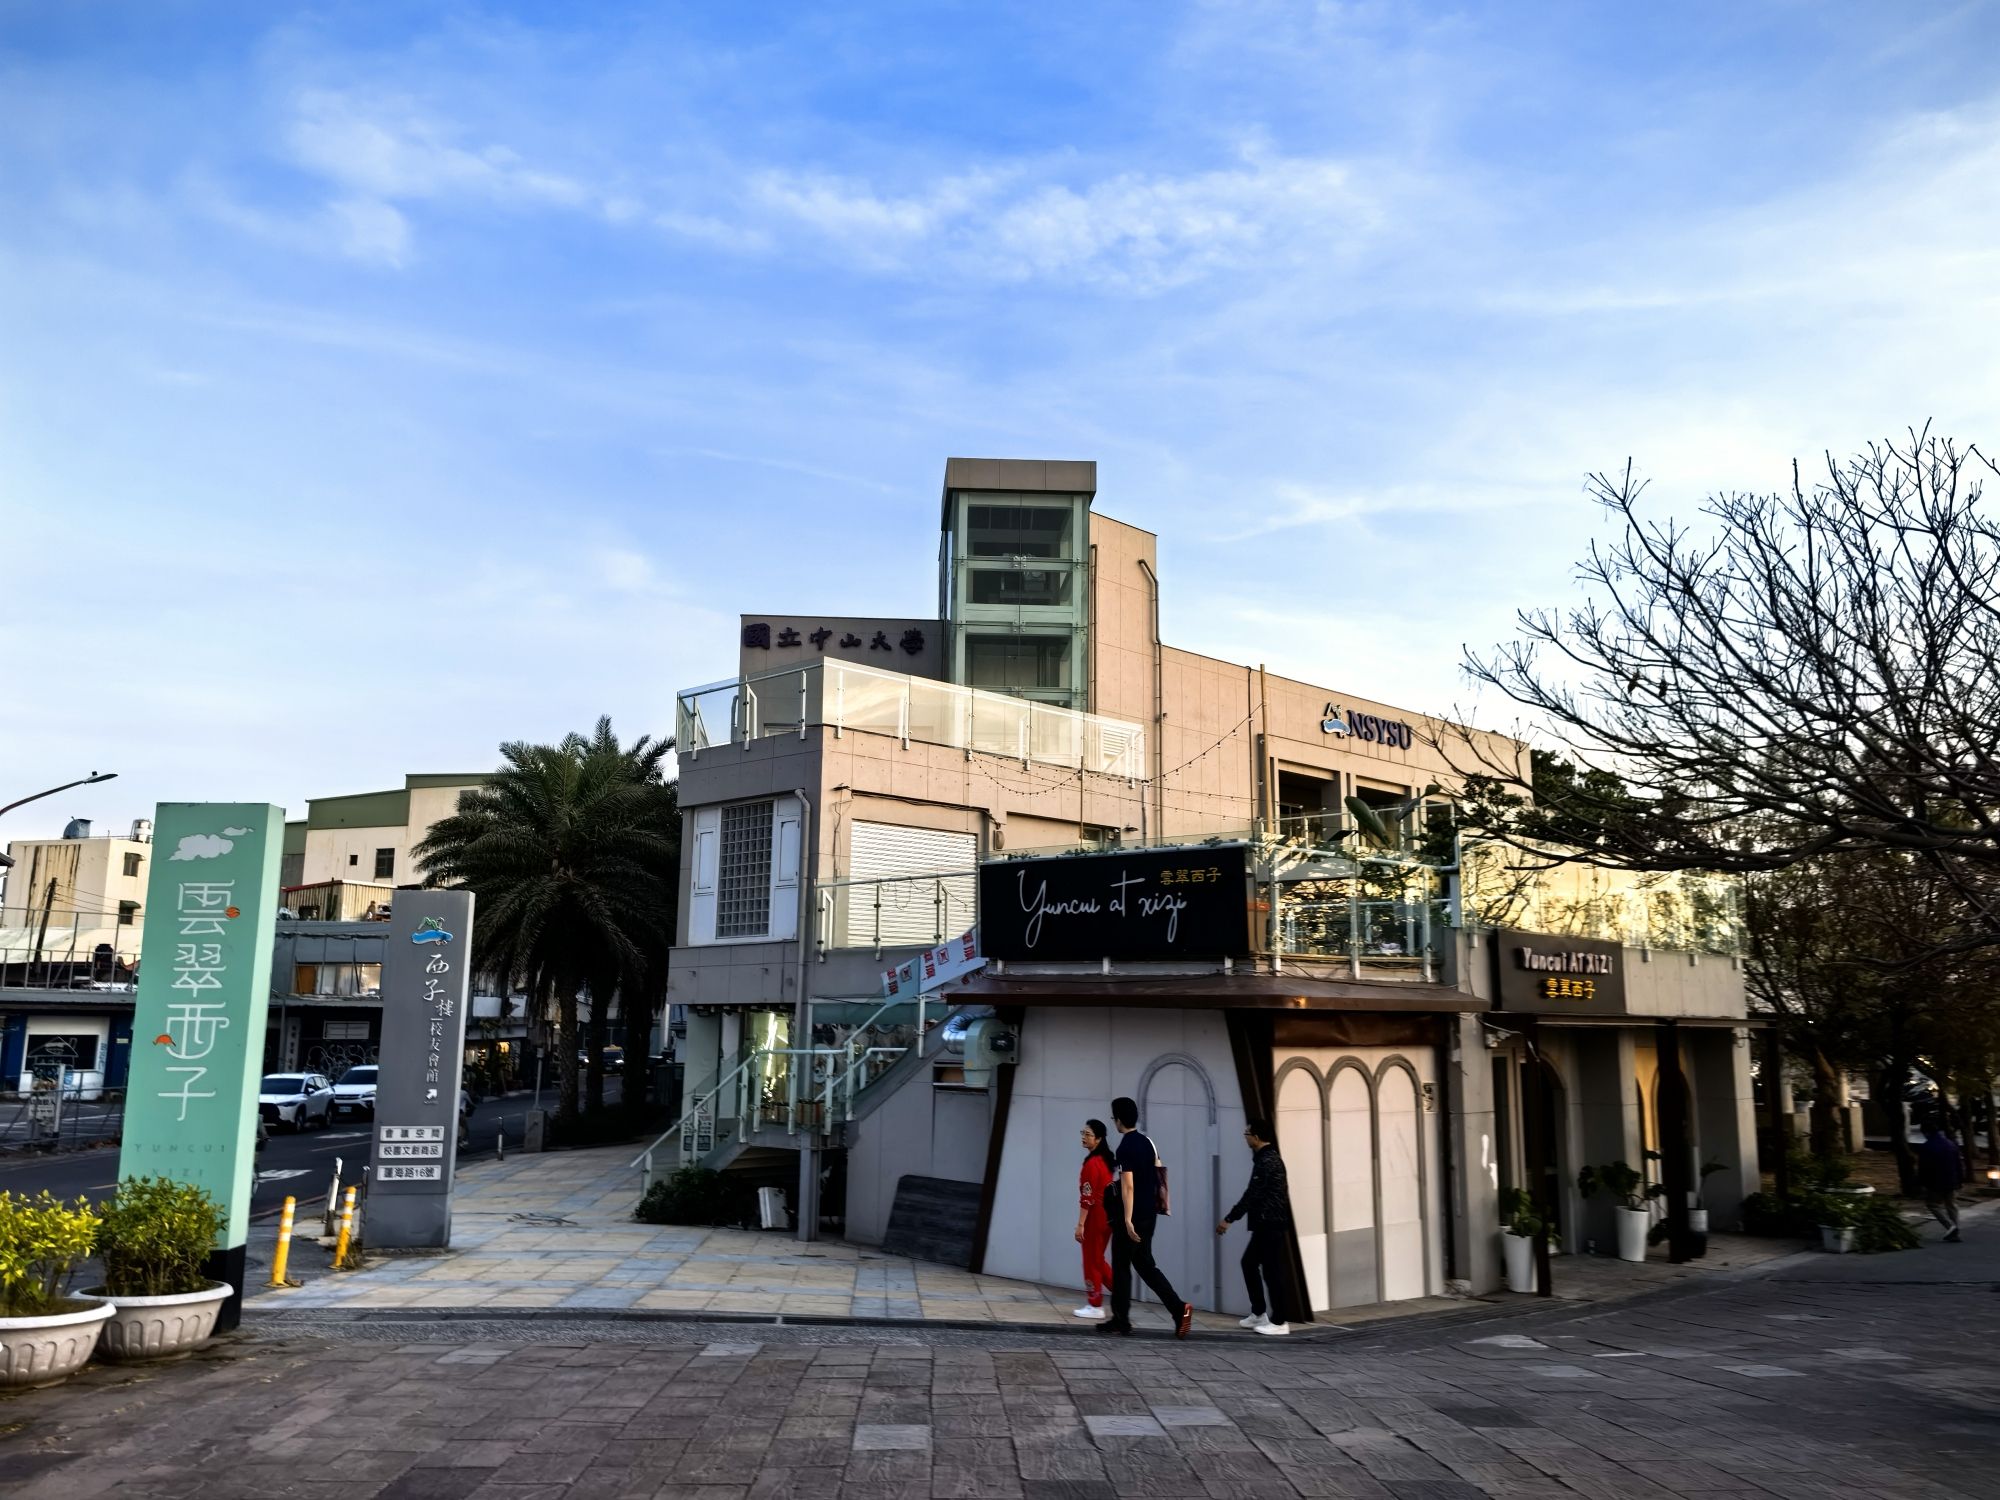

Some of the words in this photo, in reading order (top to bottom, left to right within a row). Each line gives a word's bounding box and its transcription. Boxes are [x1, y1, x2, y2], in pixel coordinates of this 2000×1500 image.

[743, 622, 925, 655] 國立中山大學
[1346, 710, 1413, 750] NSYSU
[1160, 867, 1222, 886] 雲翠西子
[1017, 869, 1101, 948] Yuncui
[1522, 947, 1567, 972] Yuncui
[1570, 952, 1585, 973] AT
[158, 879, 235, 1122] 雲翠西子
[1546, 978, 1596, 999] 雲翠西子
[134, 1143, 225, 1153] YUNCUI
